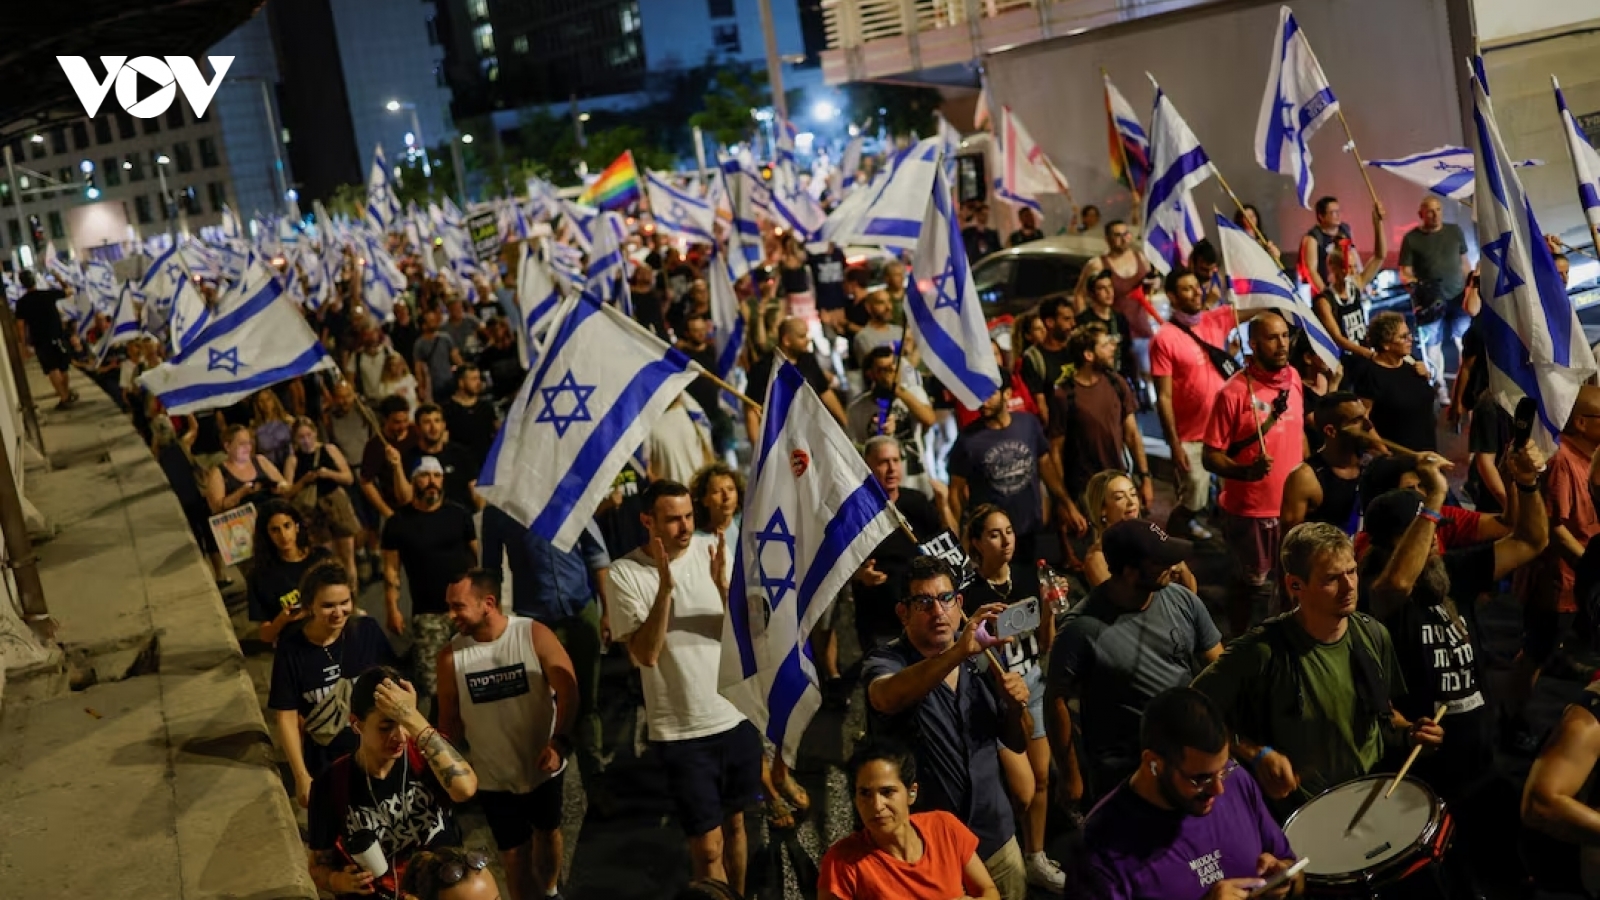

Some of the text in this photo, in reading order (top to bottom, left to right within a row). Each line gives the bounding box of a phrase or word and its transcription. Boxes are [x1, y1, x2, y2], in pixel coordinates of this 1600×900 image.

[468, 668, 523, 688] דמוקרטיה
[1188, 849, 1222, 870] MIDDLE
[1197, 860, 1220, 877] EAST
[1199, 870, 1225, 888] PORN
